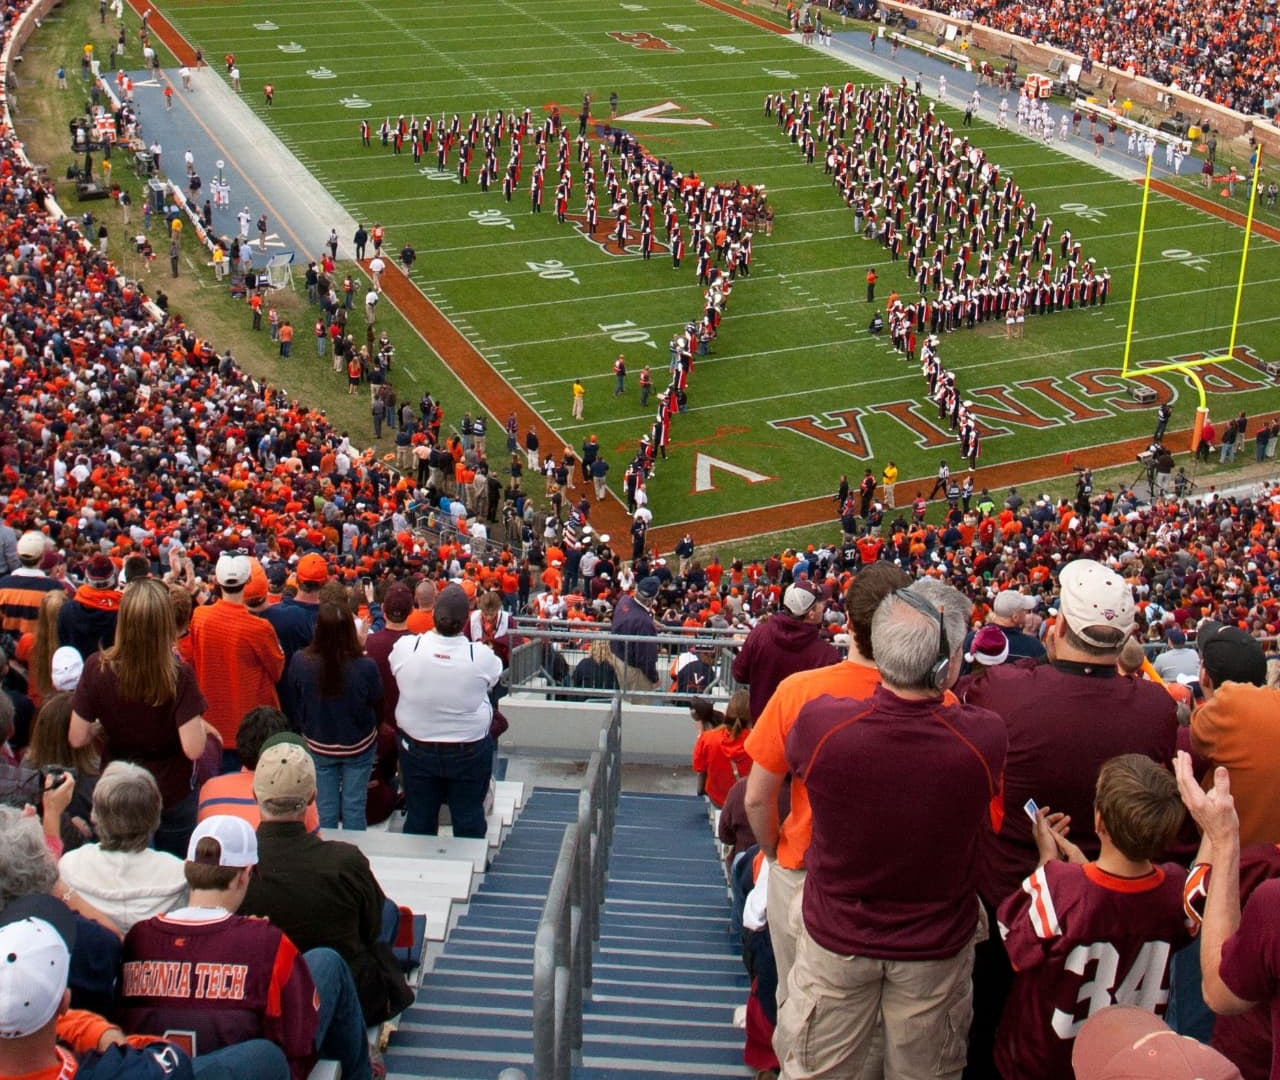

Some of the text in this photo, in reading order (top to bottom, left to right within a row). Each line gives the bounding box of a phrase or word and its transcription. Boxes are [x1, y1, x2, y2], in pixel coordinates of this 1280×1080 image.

[419, 167, 458, 181] 40
[468, 209, 511, 226] 30
[1161, 249, 1211, 267] 10
[526, 259, 574, 279] 20
[598, 320, 650, 342] 10
[844, 548, 855, 560] 37
[195, 963, 248, 1000] TECH
[1051, 940, 1170, 1039] 34
